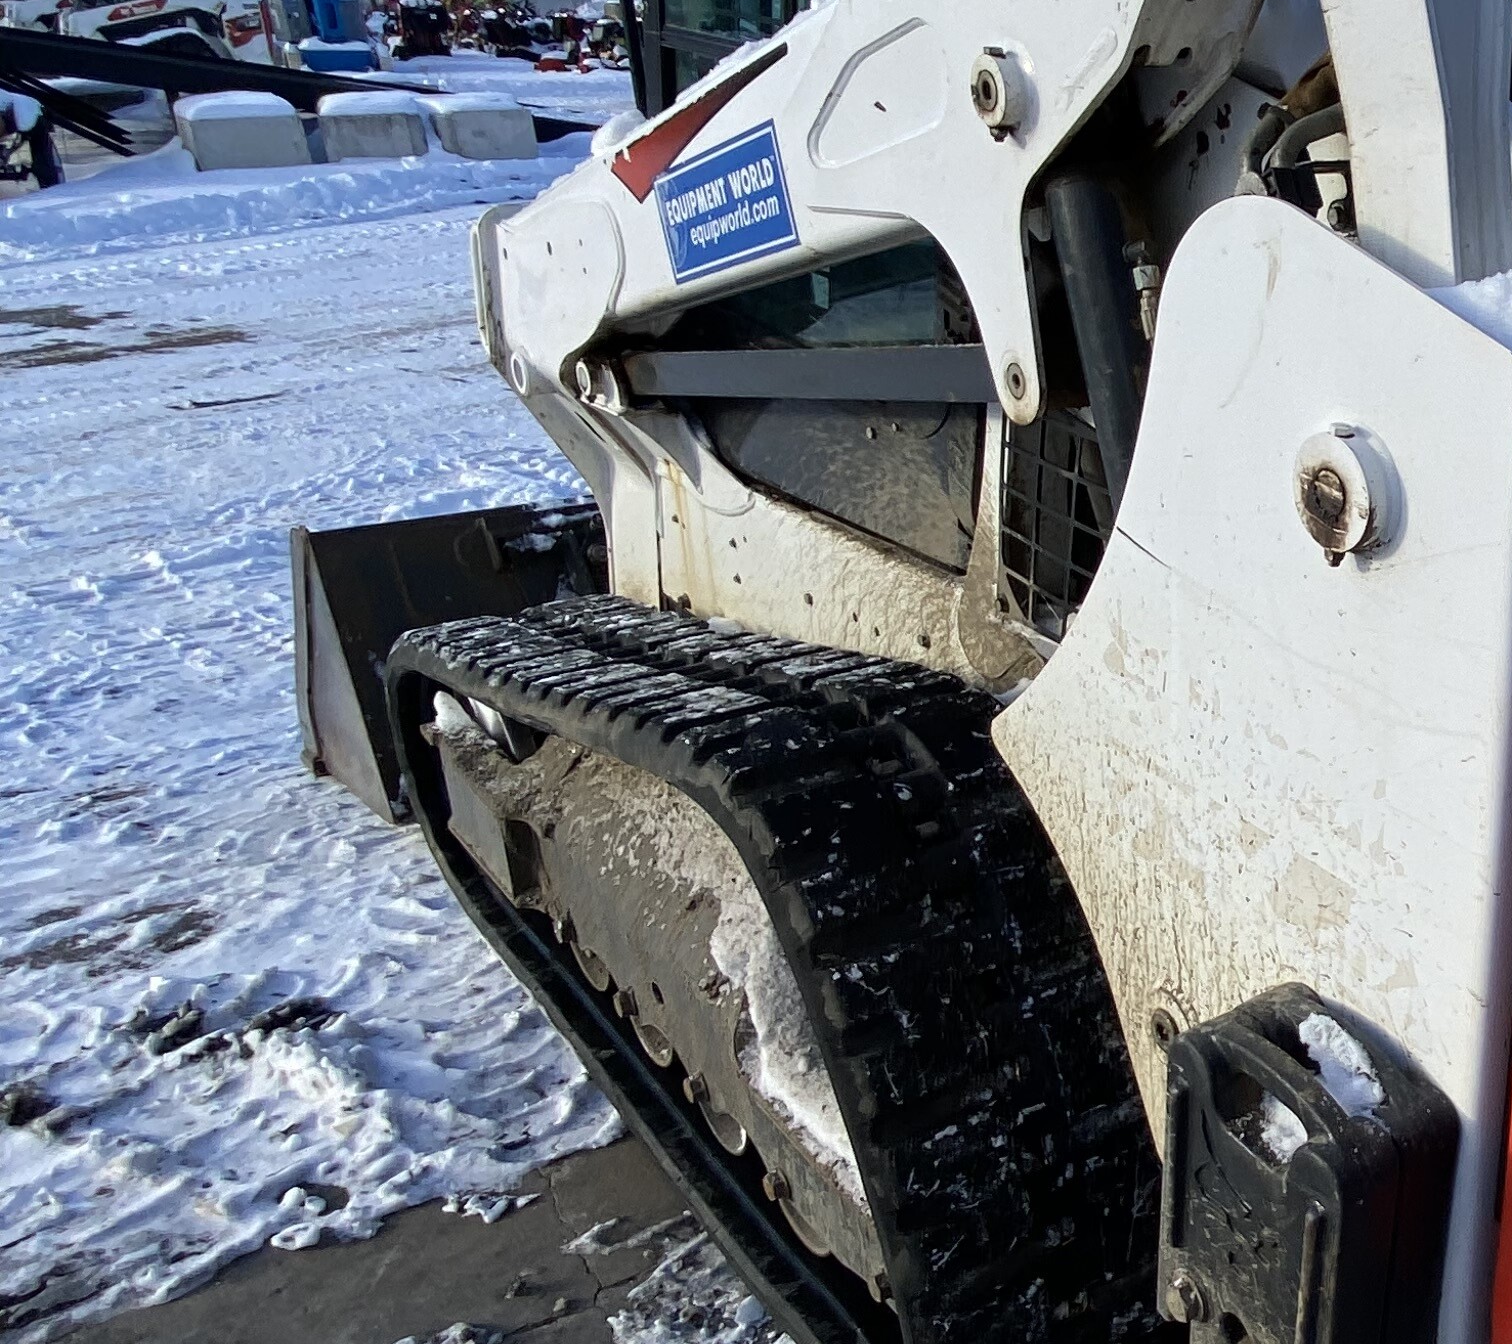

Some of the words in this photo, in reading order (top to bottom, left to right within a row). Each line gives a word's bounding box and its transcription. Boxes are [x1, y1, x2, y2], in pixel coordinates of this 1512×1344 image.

[665, 177, 728, 226] EQUIPMENT
[727, 157, 775, 200] WORLD
[689, 194, 780, 249] equipworld.com
